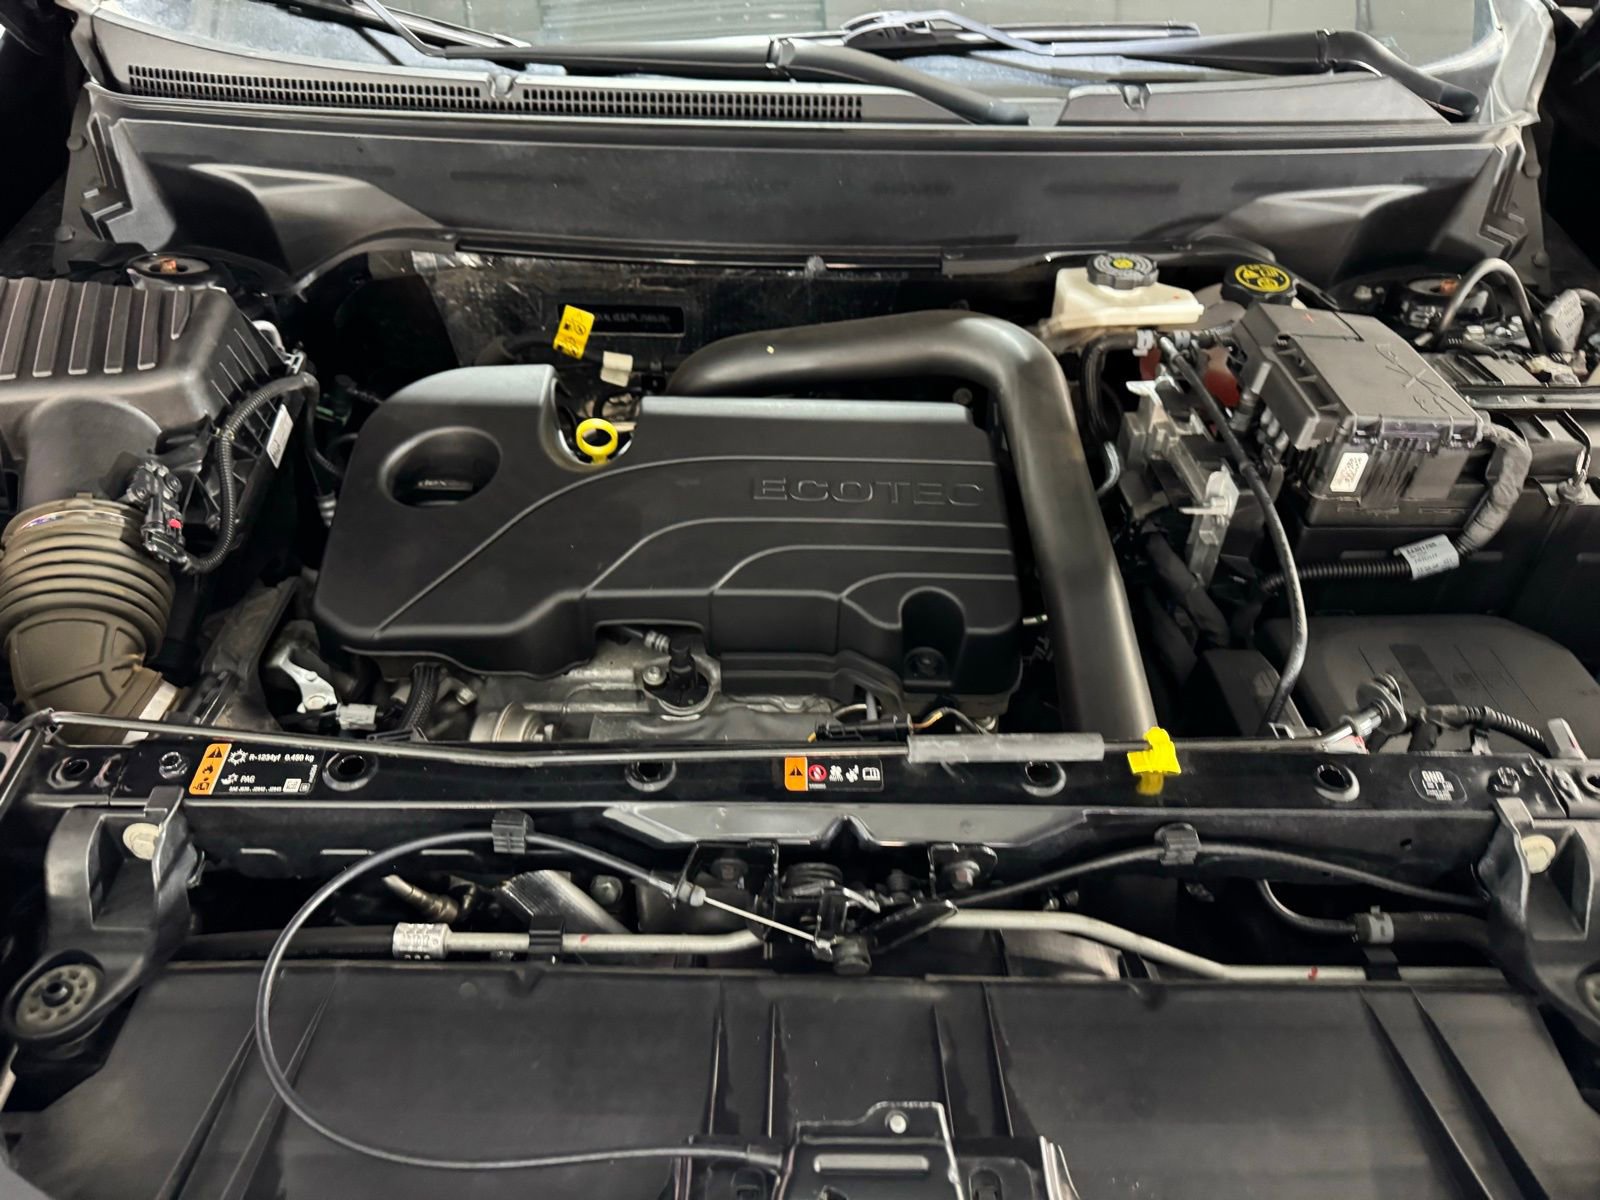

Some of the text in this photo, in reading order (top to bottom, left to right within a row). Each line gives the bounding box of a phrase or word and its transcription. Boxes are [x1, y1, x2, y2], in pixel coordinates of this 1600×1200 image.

[753, 477, 984, 507] ECOTEC
[305, 753, 315, 763] kg
[240, 775, 256, 784] PAG
